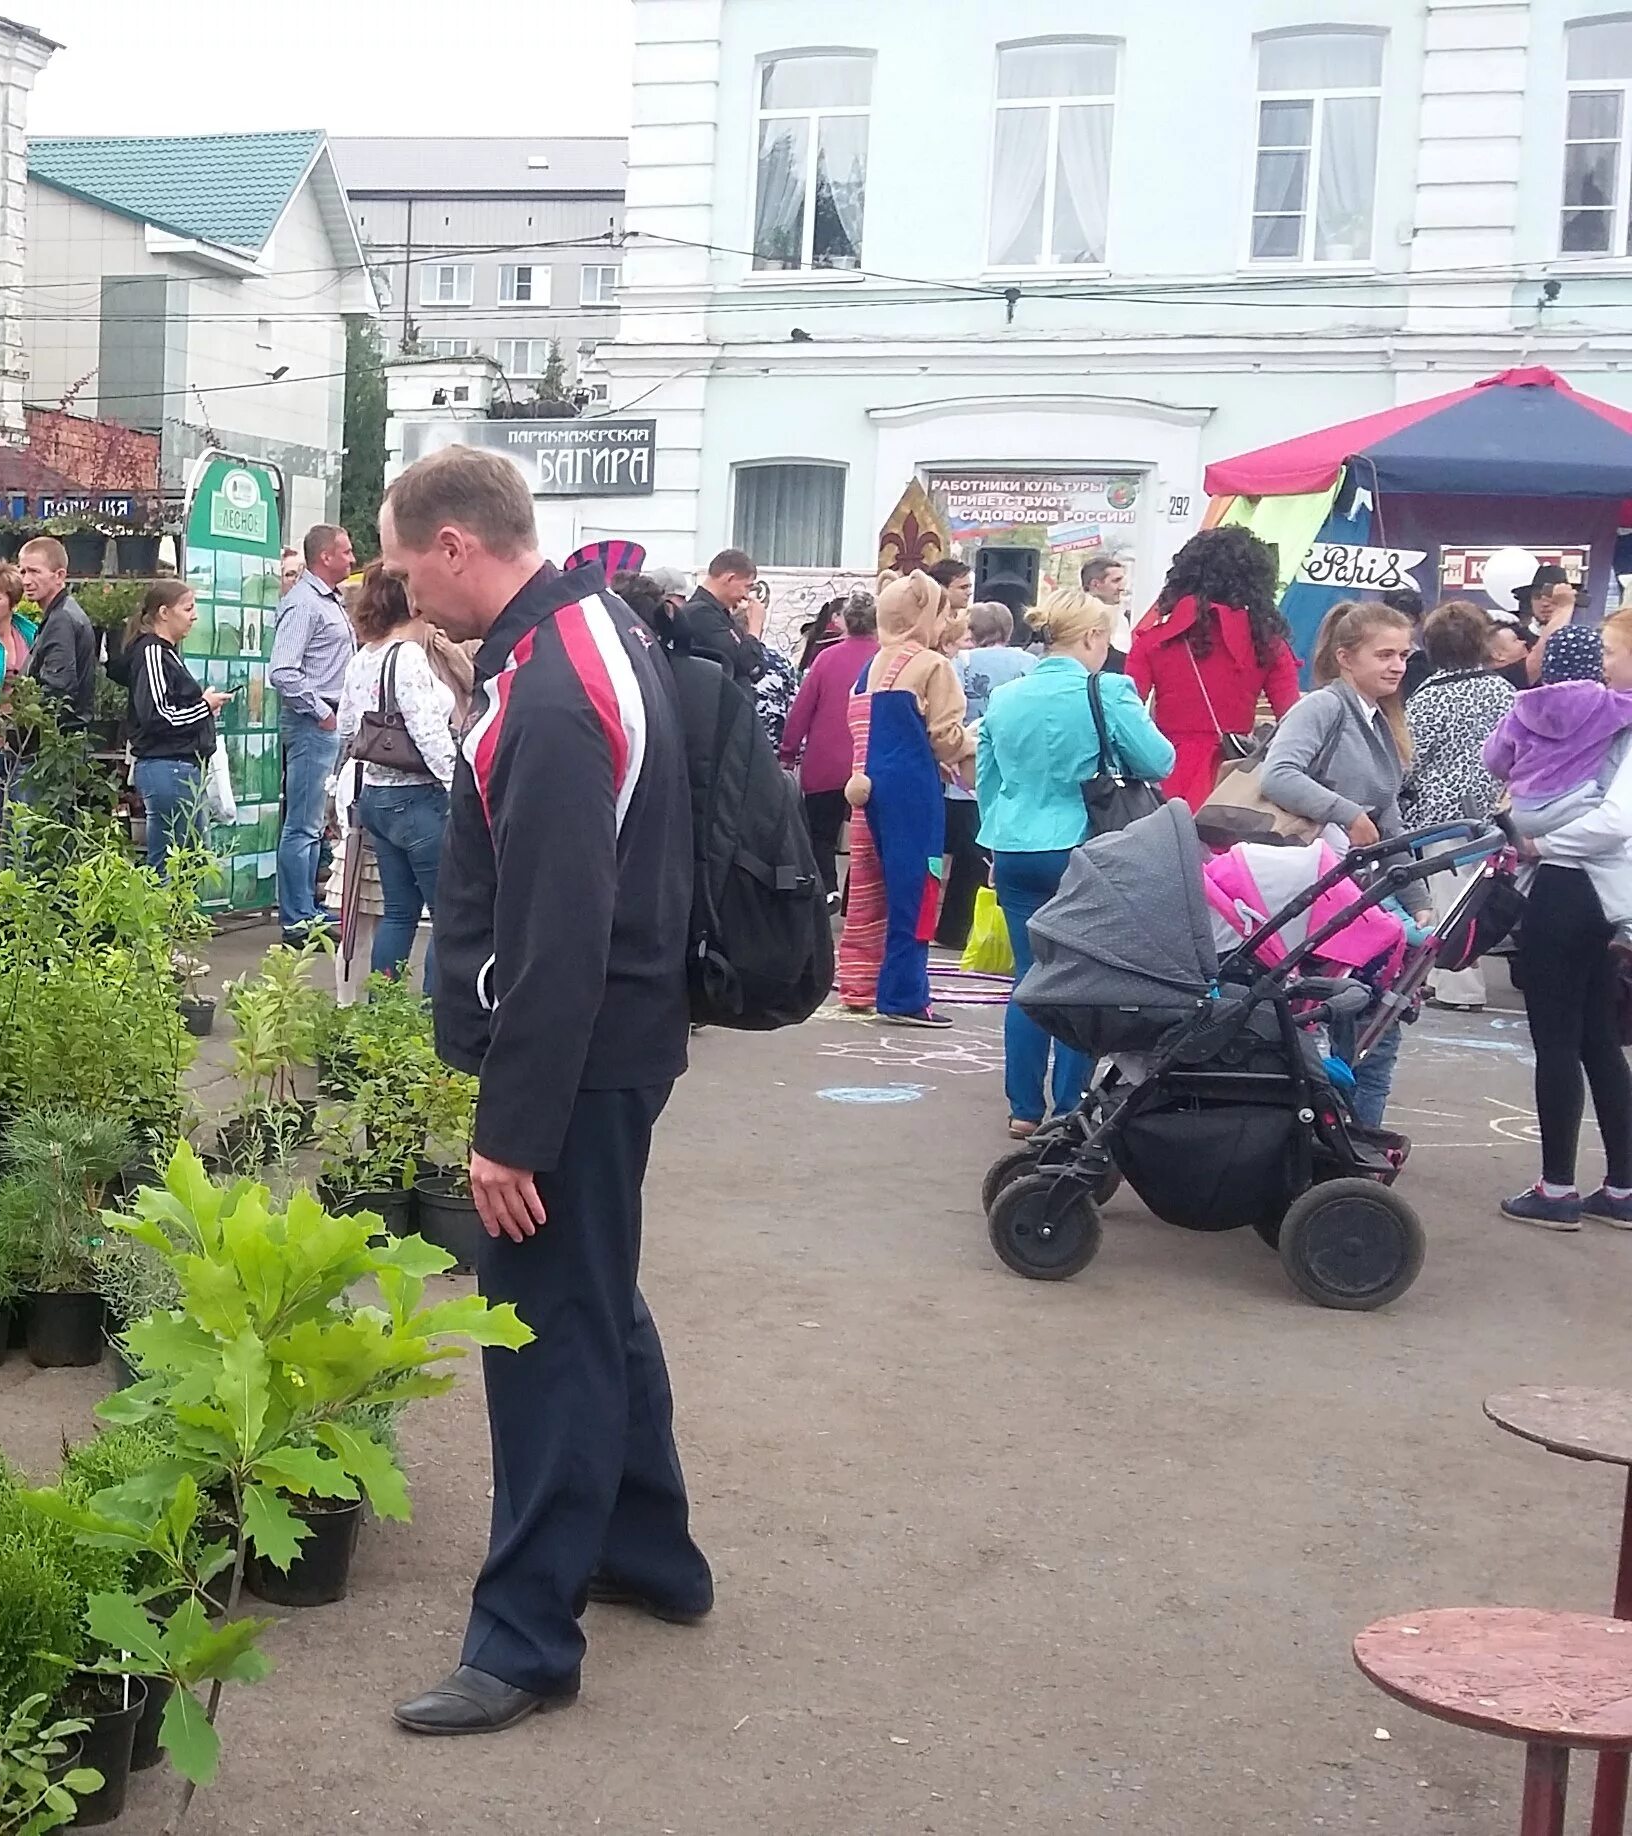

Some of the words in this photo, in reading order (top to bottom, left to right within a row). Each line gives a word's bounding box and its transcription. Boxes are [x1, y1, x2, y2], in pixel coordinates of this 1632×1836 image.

[508, 429, 650, 444] ПАРИКМАХЕРСКАЯ
[536, 447, 650, 486] БАГИРА
[931, 479, 1020, 493] РАБОТНИКИ
[1024, 480, 1104, 493] КУЛЬТУРЫ
[947, 494, 1066, 507] ПРИВЕТСТВУЮТ
[1169, 496, 1190, 516] 292
[221, 508, 258, 533] ЛЕСНОЕ
[959, 510, 1059, 524] САДОВОДОВ
[1063, 510, 1136, 524] РОССИИ!
